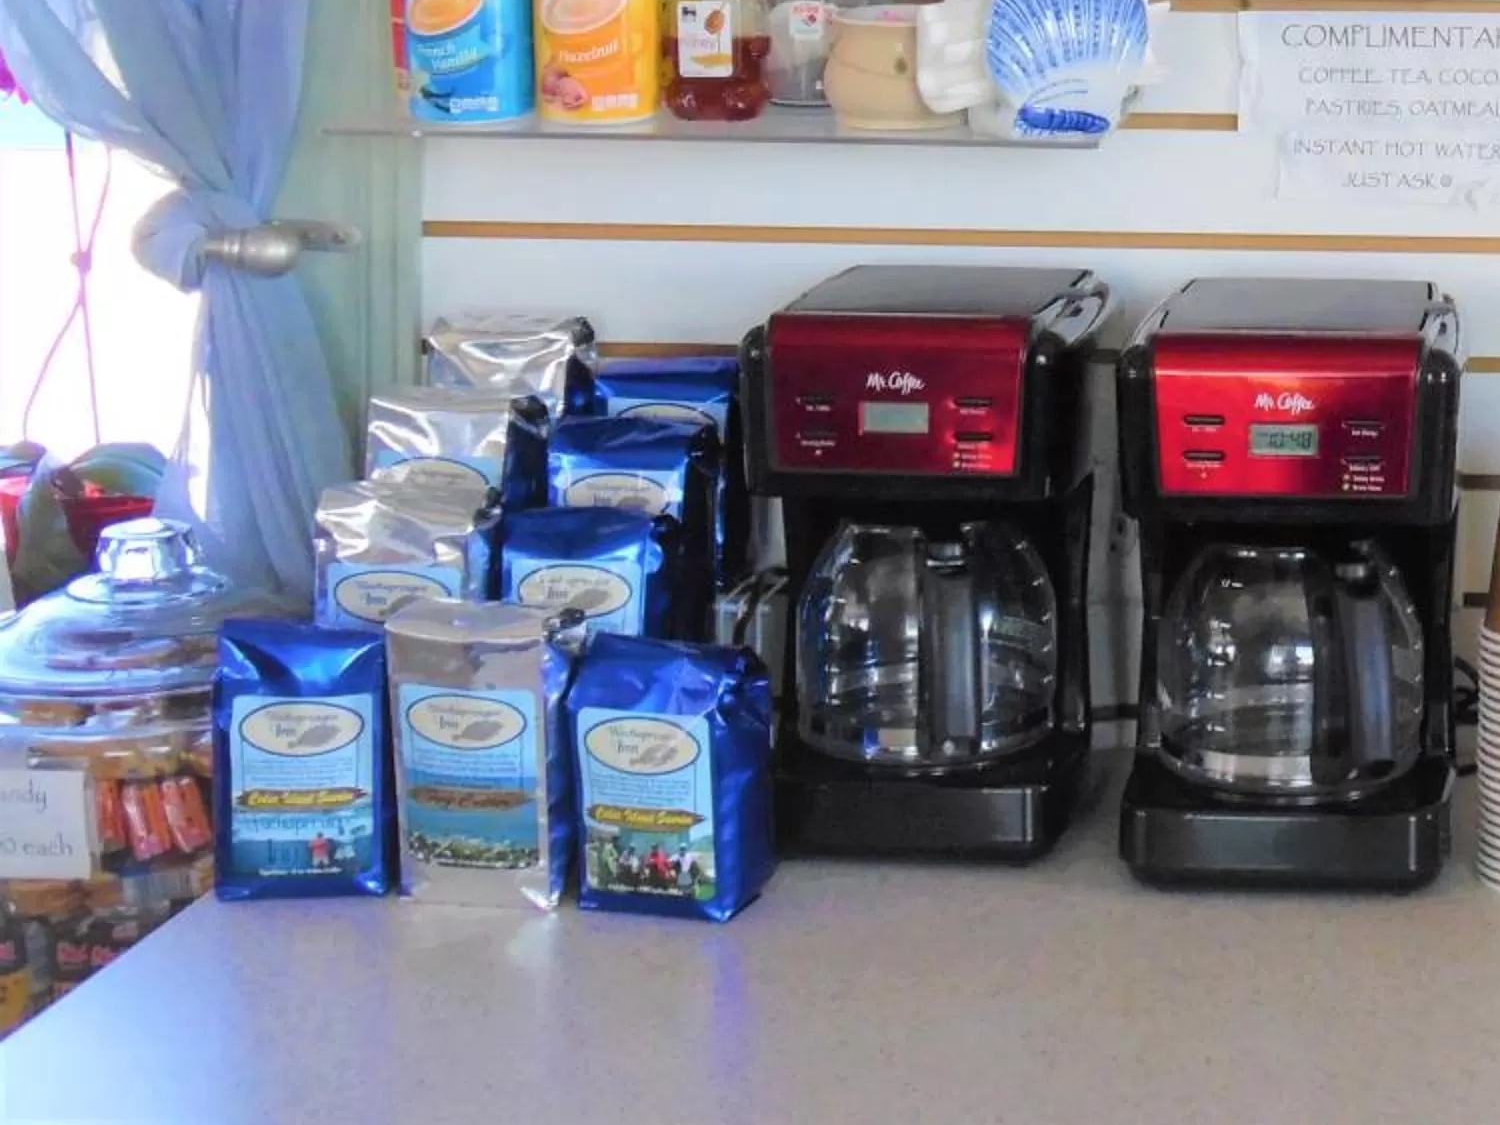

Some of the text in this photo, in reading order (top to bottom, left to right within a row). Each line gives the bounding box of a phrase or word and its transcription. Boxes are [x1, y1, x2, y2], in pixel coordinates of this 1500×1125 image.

[1293, 138, 1376, 158] INSTANT
[1384, 139, 1427, 159] HOT
[1341, 171, 1438, 190] JUST ASK
[888, 370, 926, 396] Coffee
[1277, 391, 1317, 416] Coffee
